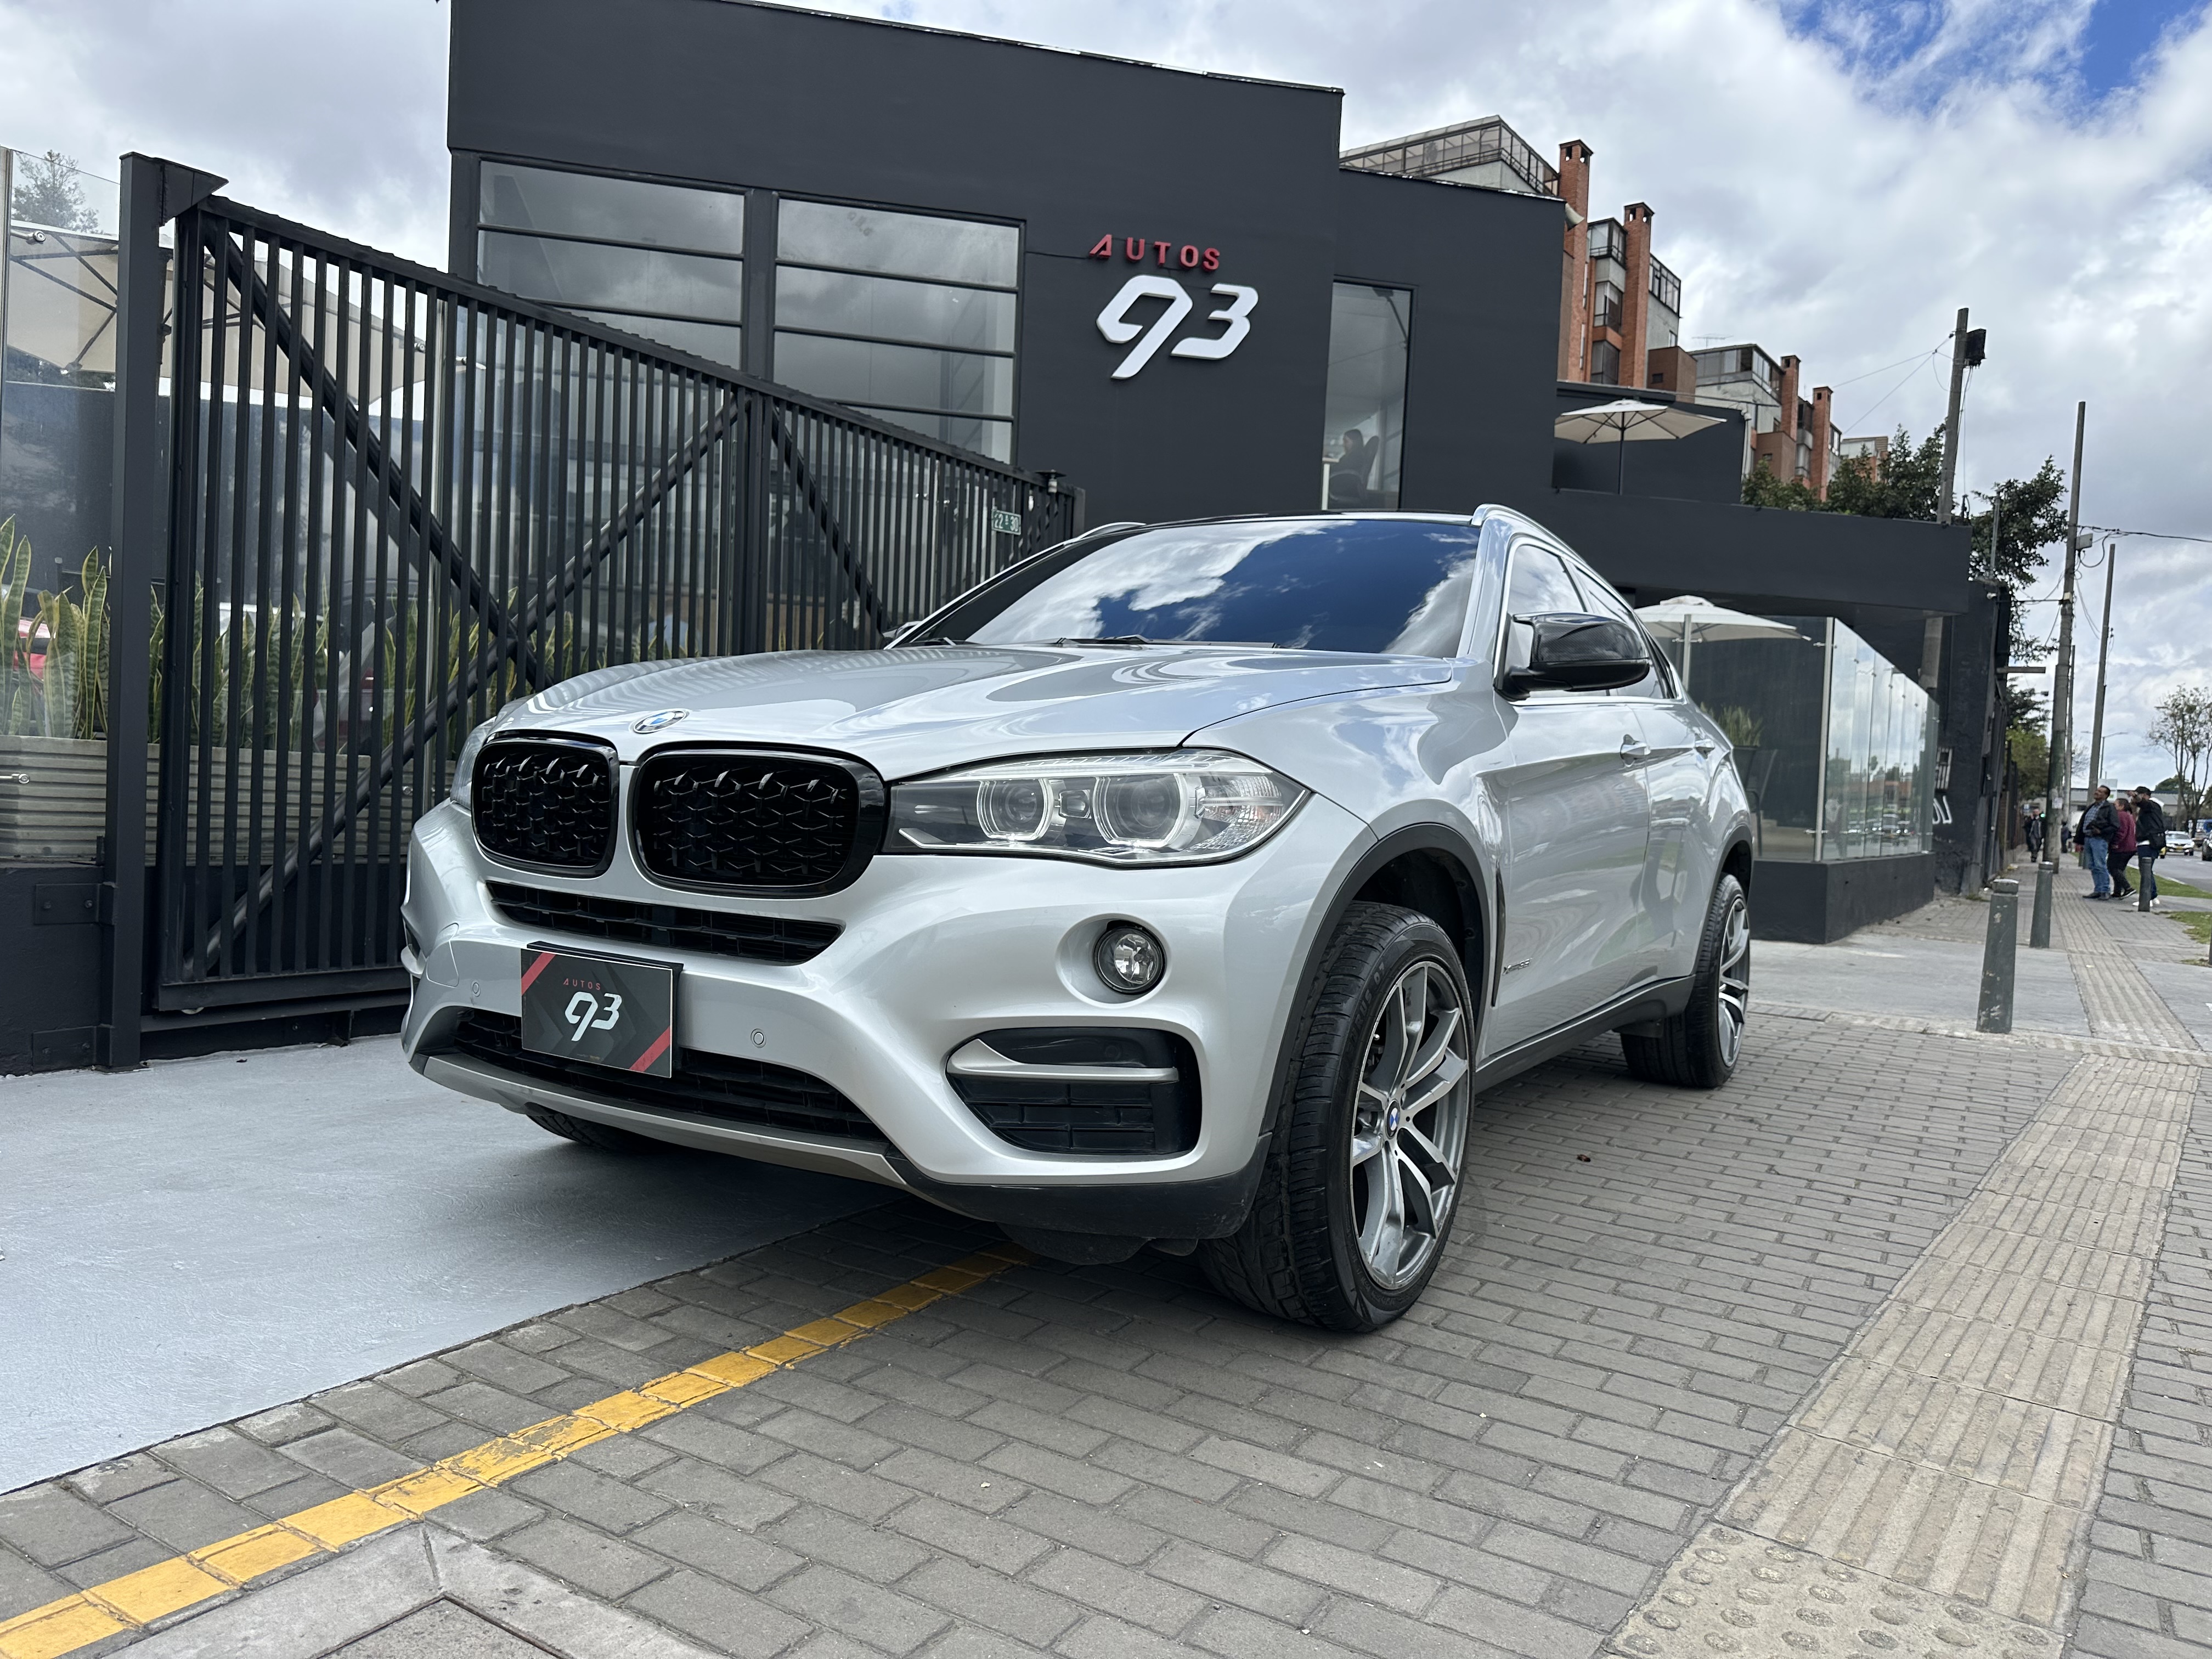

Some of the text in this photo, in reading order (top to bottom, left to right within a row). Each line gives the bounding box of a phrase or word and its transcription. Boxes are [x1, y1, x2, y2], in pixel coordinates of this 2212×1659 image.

[1089, 234, 1220, 271] AUTOS
[1096, 274, 1259, 379] 93
[563, 978, 601, 990] AUTOS
[565, 991, 622, 1041] 93
